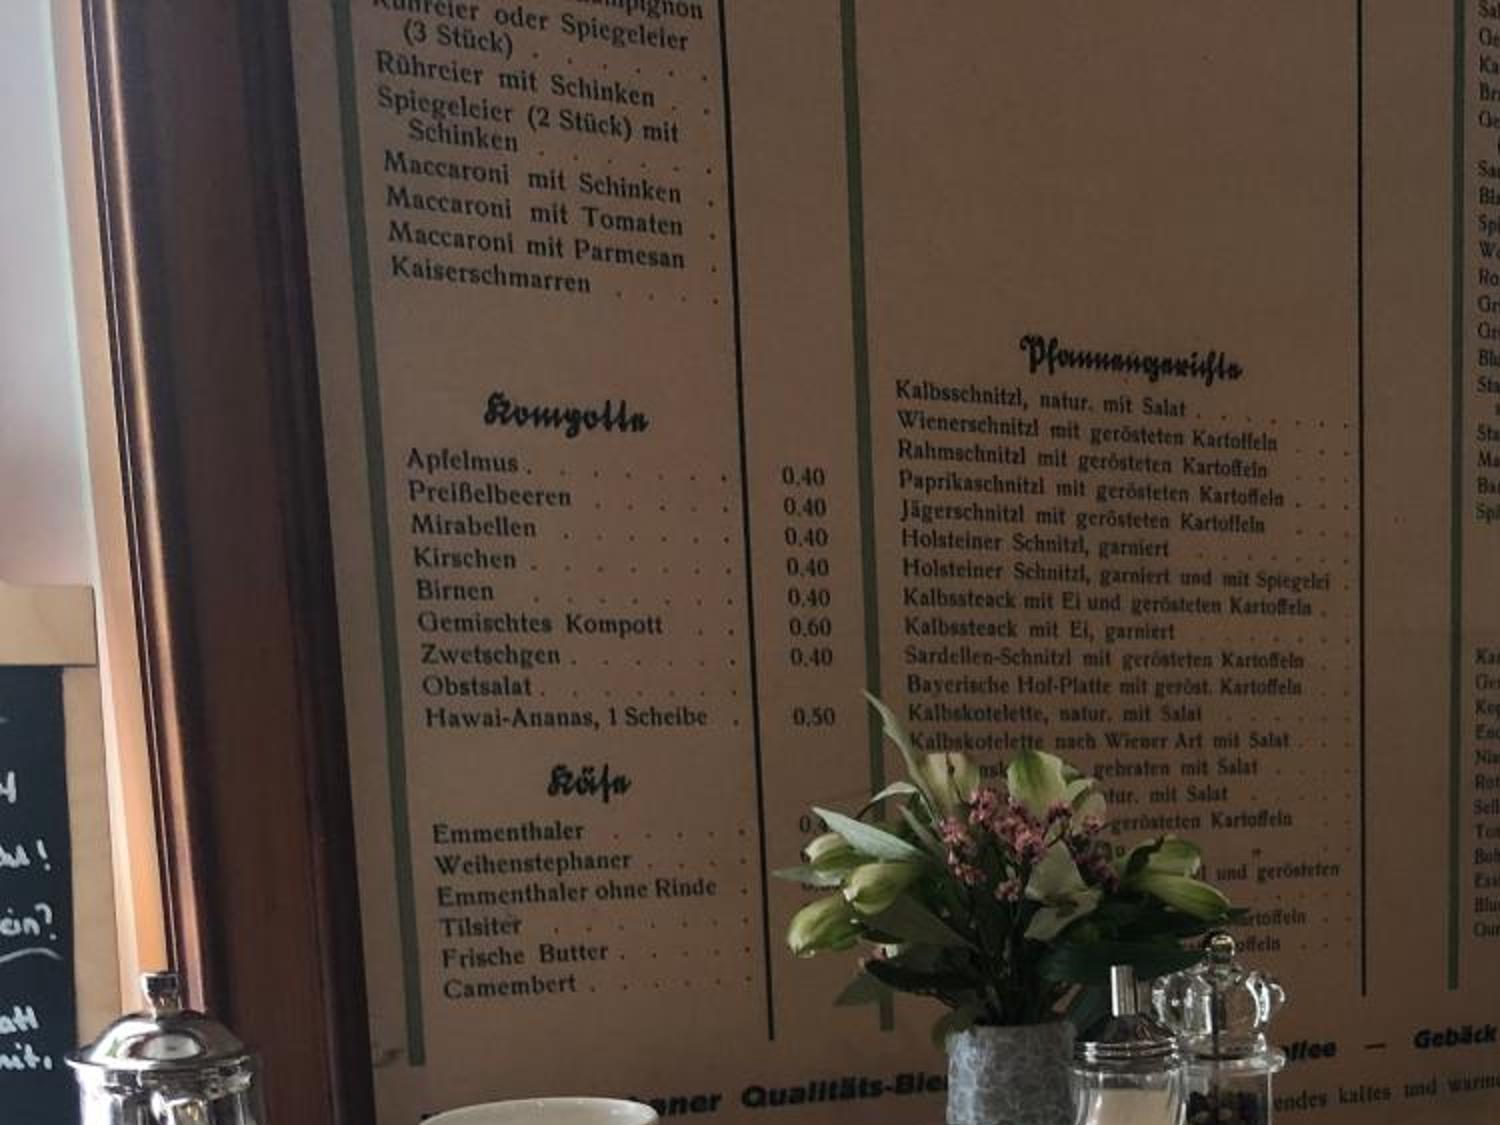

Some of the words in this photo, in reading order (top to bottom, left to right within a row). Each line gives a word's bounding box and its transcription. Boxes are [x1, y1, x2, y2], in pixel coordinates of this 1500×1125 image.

[402, 19, 428, 46] (3
[436, 23, 514, 61] Stück)
[494, 5, 548, 32] oder
[561, 13, 688, 51] Spiegeleier
[375, 49, 484, 86] Rühreier
[500, 67, 536, 92] mit
[551, 75, 655, 107] Schinken
[377, 85, 513, 123] Spiegeleier
[527, 106, 550, 134] (2
[559, 108, 632, 142] Stück)
[643, 120, 679, 144] mit
[408, 119, 519, 153] Schinken
[384, 151, 510, 185] Maccaroni
[528, 166, 567, 190] mit
[579, 173, 682, 204] Schinken
[386, 186, 512, 219] Maccaroni
[530, 202, 569, 226] mit
[582, 206, 684, 237] Tomaten
[387, 221, 514, 254] Maccaroni
[527, 235, 564, 258] mit
[575, 240, 686, 269] Parmesan
[390, 256, 591, 293] Kaiserschmarren
[896, 381, 1028, 409] Kalbsschnitzl,
[1104, 395, 1132, 414] mit
[1142, 398, 1185, 417] Salat
[896, 410, 1039, 437] Wienerschnitzl
[1051, 422, 1079, 439] mit
[1090, 423, 1184, 446] gerösteten
[1192, 430, 1278, 451] Kartoffeln
[406, 448, 519, 475] Apfelmus
[898, 440, 1025, 465] Rahmschnitzl
[1037, 450, 1068, 468] mit
[1078, 452, 1171, 475] gerösteten
[1183, 457, 1267, 478] Kartoffeln
[782, 466, 825, 487] 0.40
[899, 470, 1043, 495] Paprikaschnitzl
[1057, 479, 1085, 497] mit
[1096, 482, 1189, 504] gerösteten
[1200, 486, 1284, 507] Kartoffeln
[408, 480, 572, 507] Preißelbeeren
[783, 498, 826, 518] 0.40
[901, 500, 1024, 524] Jägerschnitzl
[1035, 507, 1065, 525] mit
[1075, 509, 1169, 531] gerösteten
[1180, 513, 1265, 534] Kartoffeln
[411, 515, 536, 538] Mirabellen
[785, 528, 828, 547] 0.40
[901, 529, 1001, 550] Holsteiner
[1013, 534, 1089, 556] Schnitzl,
[1099, 539, 1168, 559] garniert
[414, 547, 516, 570] Kirschen
[786, 558, 829, 577] 0.40
[903, 558, 1003, 579] Holsteiner
[1014, 562, 1091, 584] Schnitzl,
[1101, 567, 1169, 587] garniert
[1181, 569, 1212, 587] und
[1223, 571, 1249, 588] mit
[1256, 571, 1330, 593] Spiegelei
[416, 580, 494, 601] Birnen
[788, 590, 830, 608] 0.40
[903, 588, 1016, 610] Kalbssteack
[1024, 592, 1053, 610] mit
[1062, 592, 1080, 610] Ei
[1088, 594, 1119, 612] und
[1131, 594, 1221, 616] gerösteten
[1230, 596, 1312, 616] Kartoffeln
[417, 612, 553, 634] Gemischtes
[567, 614, 662, 638] Kompott
[789, 619, 831, 637] 0.60
[904, 617, 1017, 638] Kalbssteack
[1030, 620, 1058, 638] mit
[1070, 621, 1094, 641] Ei,
[1105, 622, 1174, 642] garniert
[420, 644, 560, 670] Zwetschgen
[791, 648, 832, 667] 0.40
[905, 647, 1071, 667] Sardellen-Schnitzl
[1083, 650, 1111, 667] mit
[1122, 651, 1212, 672] gerösteten
[1221, 651, 1304, 669] Kartoffeln
[423, 676, 531, 696] Obstsalat
[907, 674, 1008, 697] Bayerische
[1017, 676, 1110, 696] Hof-Platte
[1119, 678, 1147, 695] mit
[1155, 678, 1212, 699] geröst.
[1220, 677, 1302, 696] Kartoffeln
[426, 708, 599, 730] Hawai-Ananas,
[609, 708, 617, 727] 1
[624, 706, 707, 727] Scheibe
[792, 708, 835, 727] 0.50
[908, 704, 1049, 726] Kalbskotelette,
[1123, 706, 1150, 722] mit
[1160, 704, 1201, 722] Salat
[433, 823, 584, 845] Emmenthaler
[434, 852, 631, 876] Weihenstephaner
[438, 880, 586, 907] Emmenthaler
[596, 879, 648, 899] ohne
[655, 876, 716, 898] Rinde
[441, 918, 522, 938] Tilsiter
[442, 947, 524, 969] Frische
[539, 943, 608, 963] Butter
[444, 975, 576, 999] Camembert
[1414, 1024, 1496, 1050] Gebäck
[1339, 1080, 1391, 1105] kaltes
[1404, 1075, 1438, 1099] und
